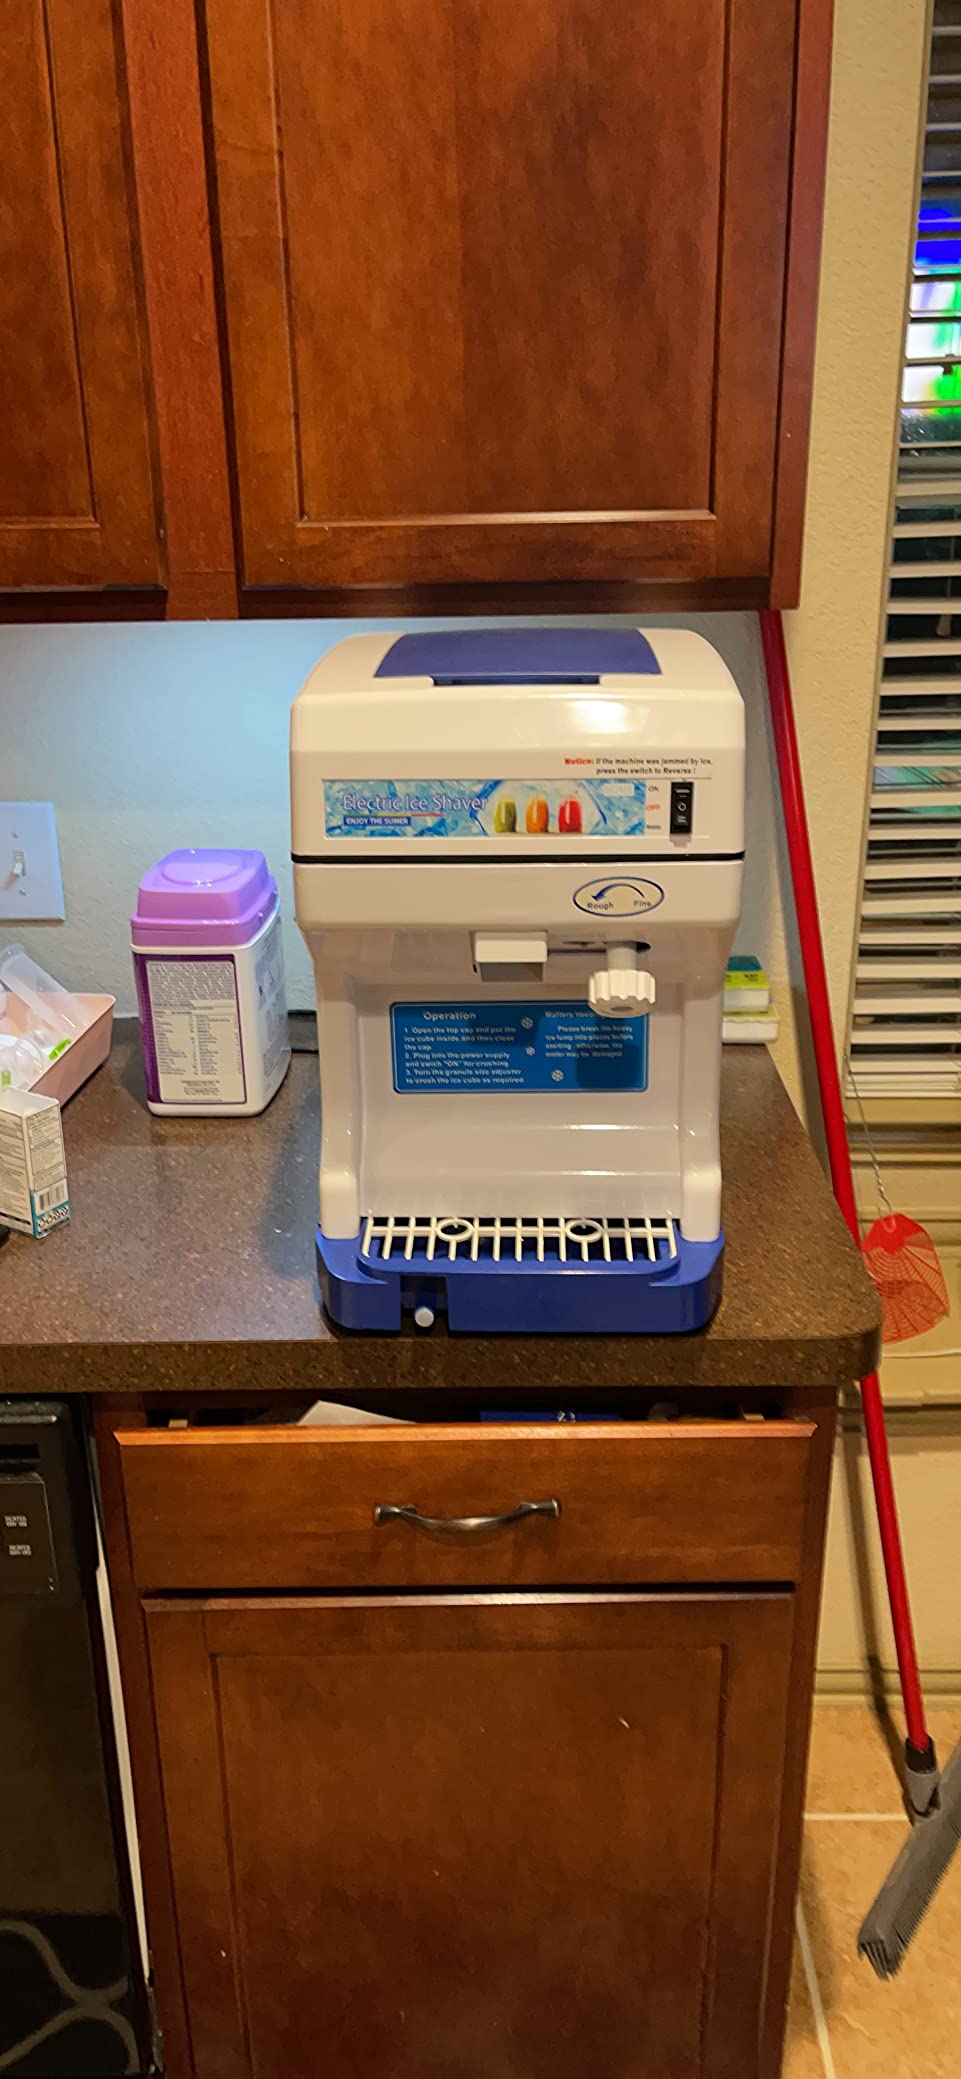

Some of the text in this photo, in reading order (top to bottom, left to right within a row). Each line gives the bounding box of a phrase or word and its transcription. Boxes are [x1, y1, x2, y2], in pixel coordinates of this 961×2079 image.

[661, 758, 689, 766] jammed
[690, 758, 699, 767] by
[342, 793, 488, 812] Electric Ice Shaver
[346, 817, 369, 825] ENJOY
[370, 817, 383, 825] THE
[587, 902, 614, 911] Rough
[633, 900, 652, 908] Fine
[423, 1011, 477, 1021] Operation
[412, 1027, 433, 1035] Open
[446, 1027, 459, 1035] top
[413, 1052, 431, 1060] Plug
